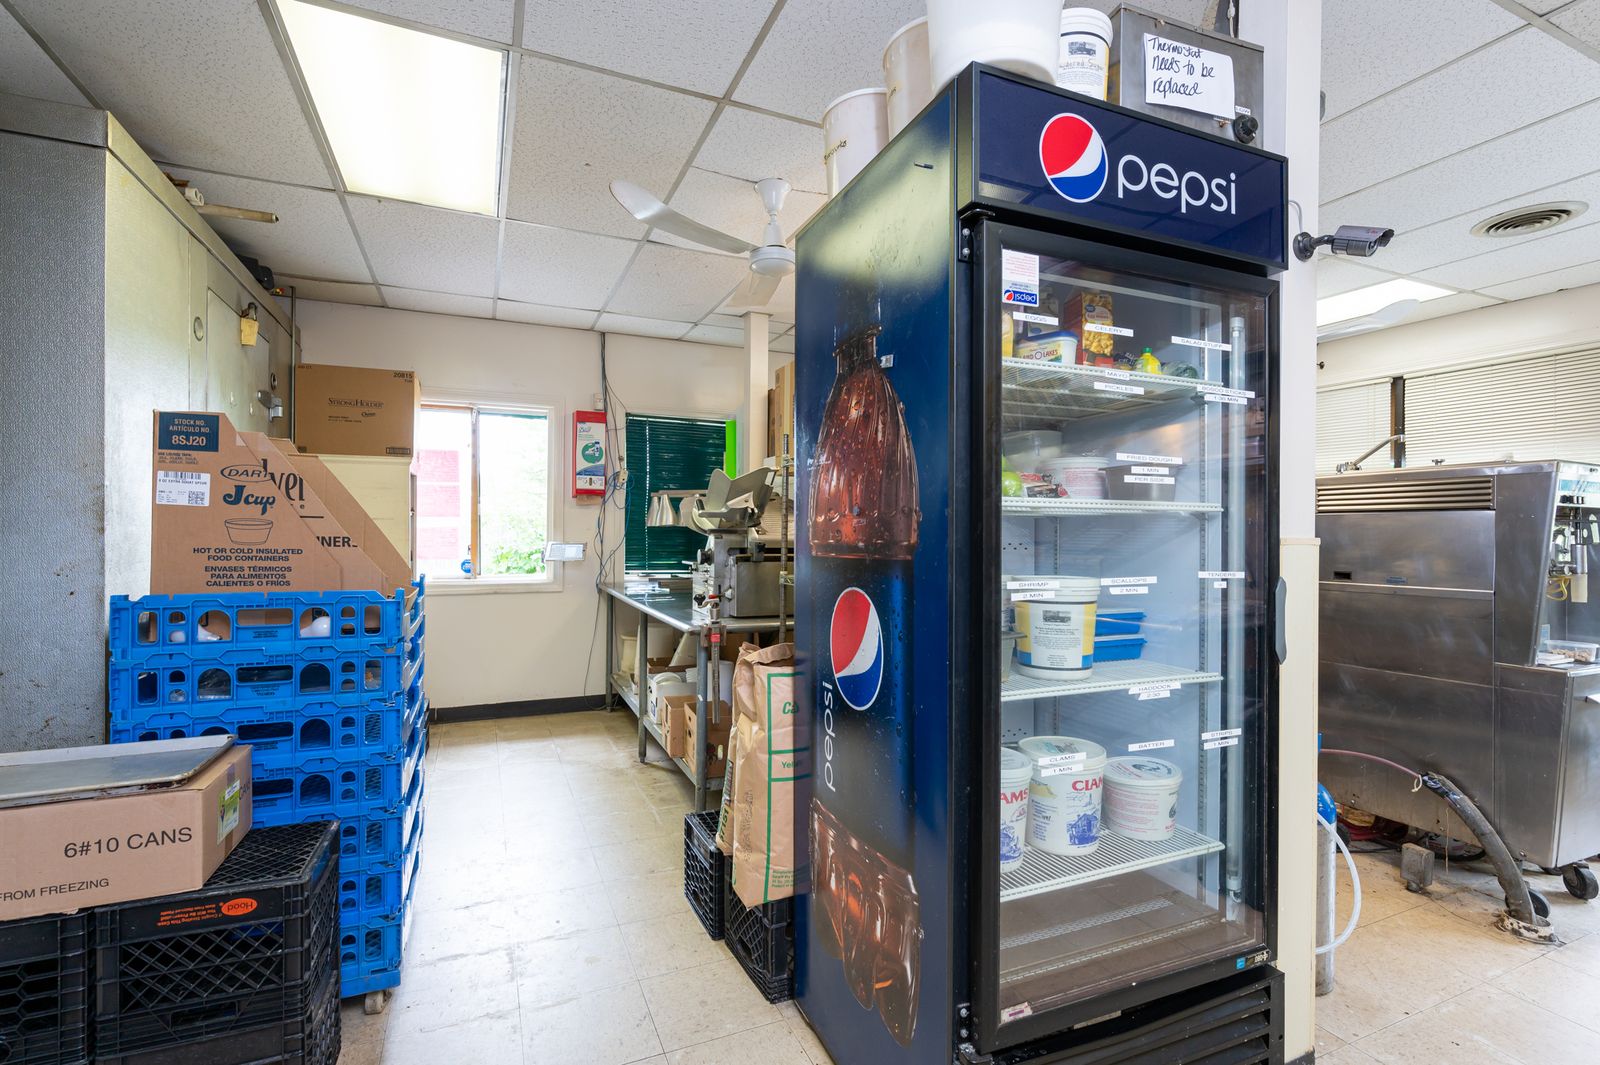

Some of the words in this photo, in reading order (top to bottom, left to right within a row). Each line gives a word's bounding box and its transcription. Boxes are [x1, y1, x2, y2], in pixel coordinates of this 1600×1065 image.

[1183, 60, 1195, 75] to
[1201, 62, 1215, 78] be
[1153, 78, 1203, 99] replaced
[1117, 154, 1236, 214] pepsi
[1014, 293, 1036, 302] pepsi
[172, 435, 206, 446] 8SJ20
[822, 680, 836, 792] pepsi
[64, 837, 119, 858] 6#10
[127, 827, 192, 850] CANS
[40, 878, 110, 895] FREEZING
[228, 901, 253, 912] Hood
